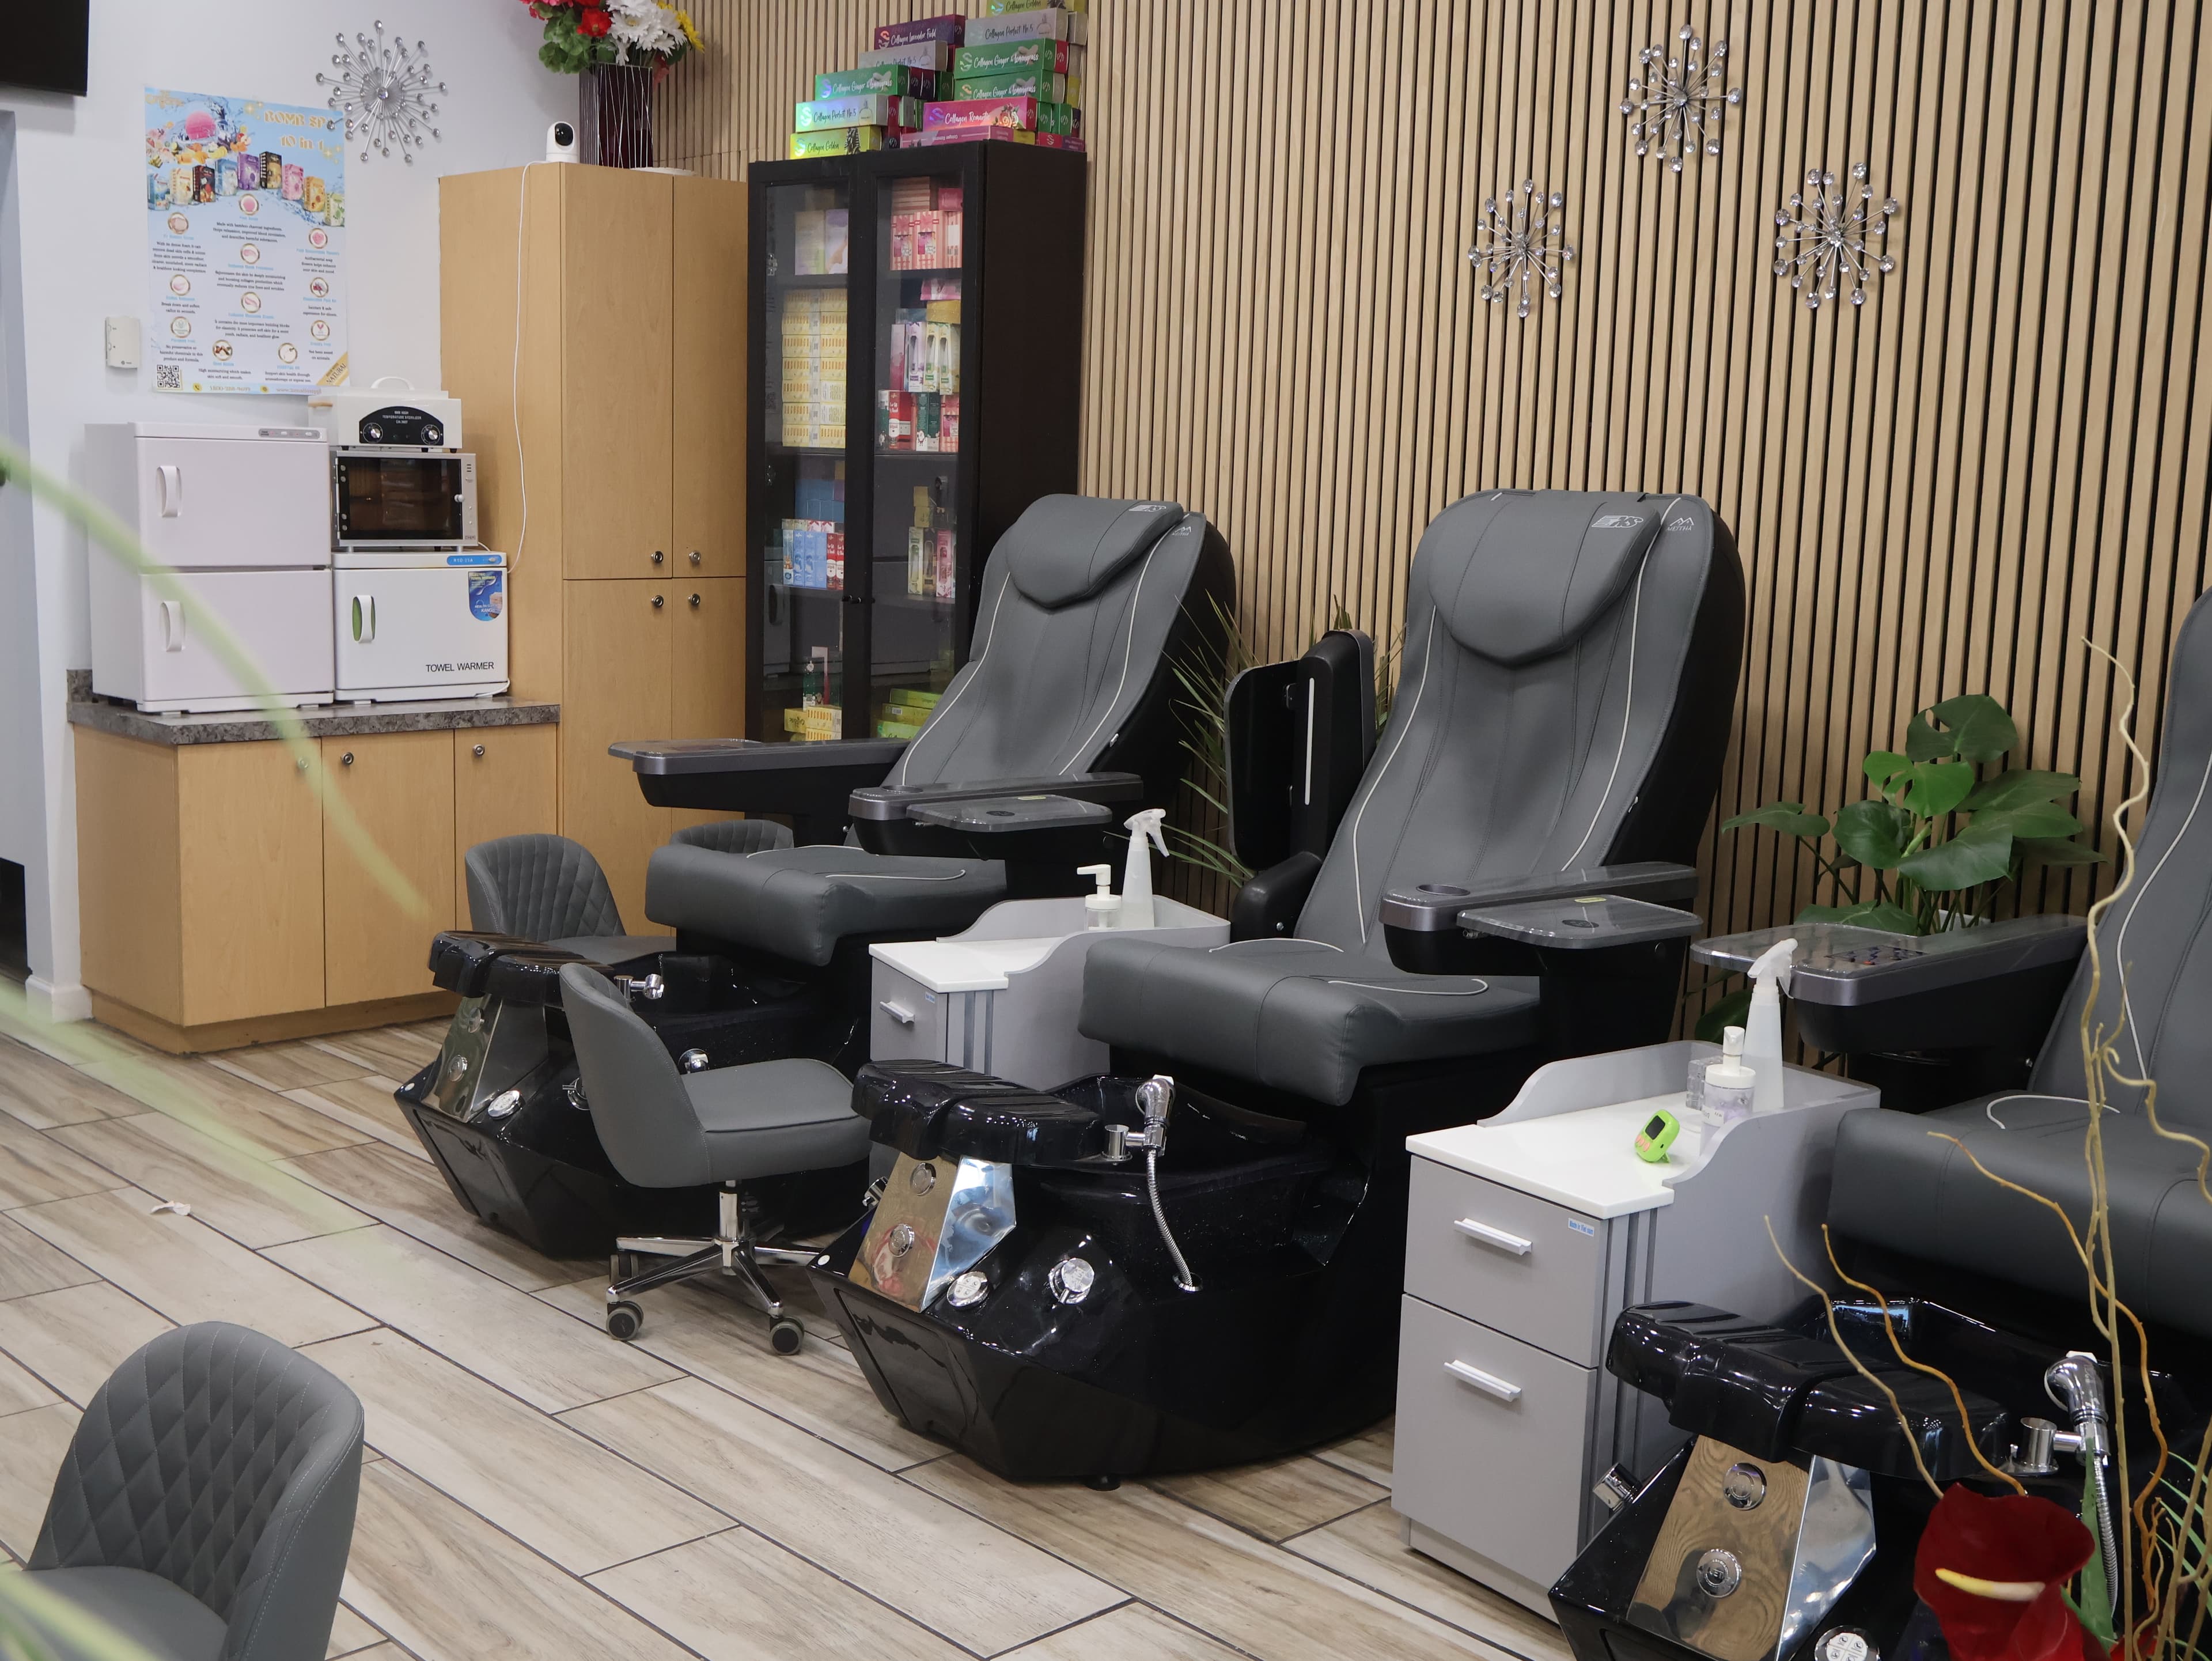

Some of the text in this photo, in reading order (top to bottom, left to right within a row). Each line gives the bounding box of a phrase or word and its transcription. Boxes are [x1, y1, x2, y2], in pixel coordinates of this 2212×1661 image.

[985, 28, 1004, 41] Collagen
[974, 57, 993, 69] Collagen
[309, 115, 331, 129] SP
[814, 112, 831, 123] Collagen
[945, 113, 967, 126] Collagen
[807, 143, 824, 155] Collagen
[426, 662, 494, 672] TOWEL WARMER
